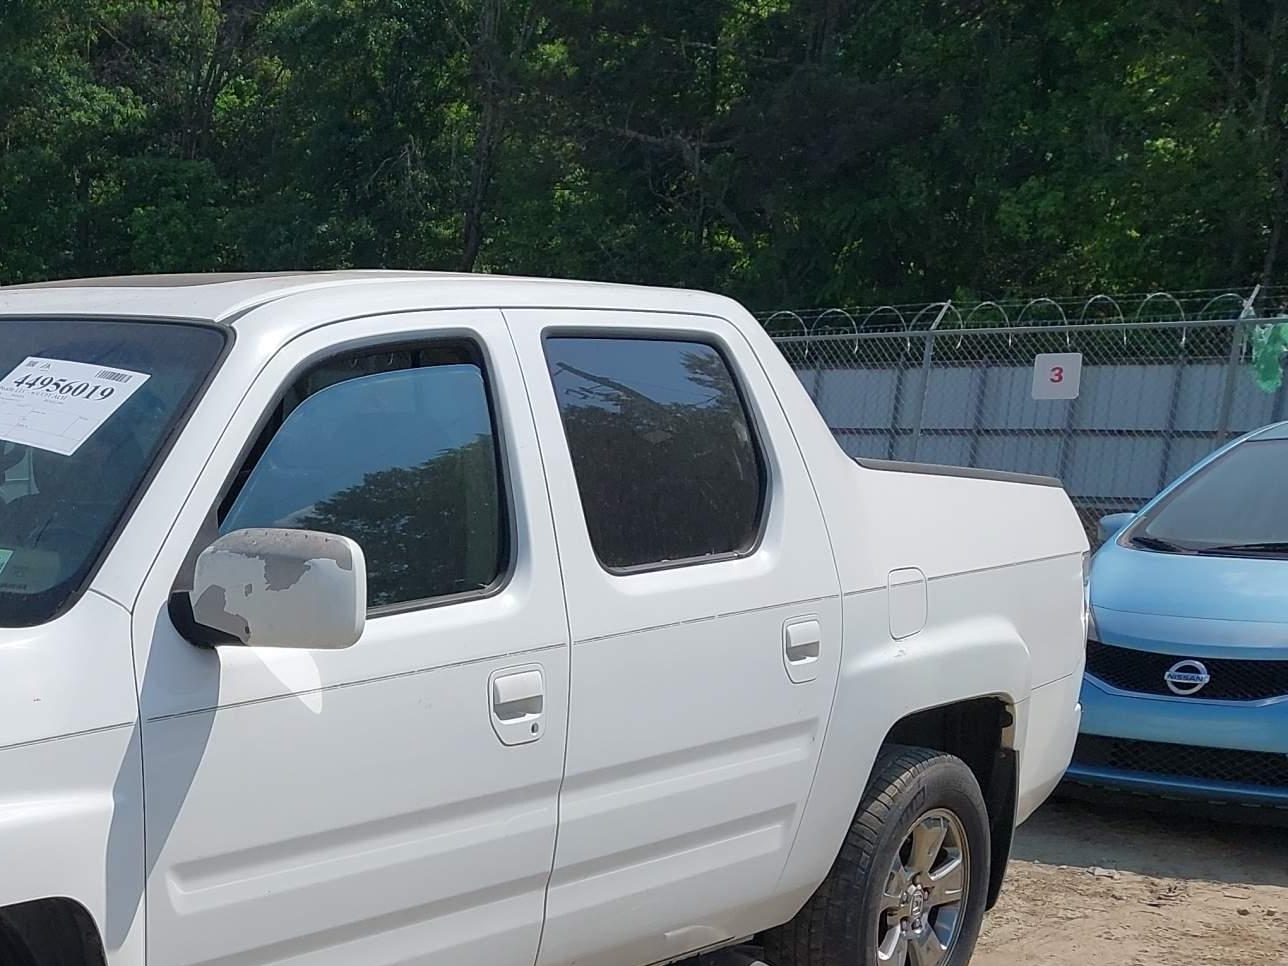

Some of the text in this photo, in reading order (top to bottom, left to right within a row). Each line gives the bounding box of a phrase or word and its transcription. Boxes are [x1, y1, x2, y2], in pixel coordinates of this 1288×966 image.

[1049, 366, 1064, 383] 3
[14, 374, 116, 401] 44956019
[1166, 673, 1204, 682] NISSAN
